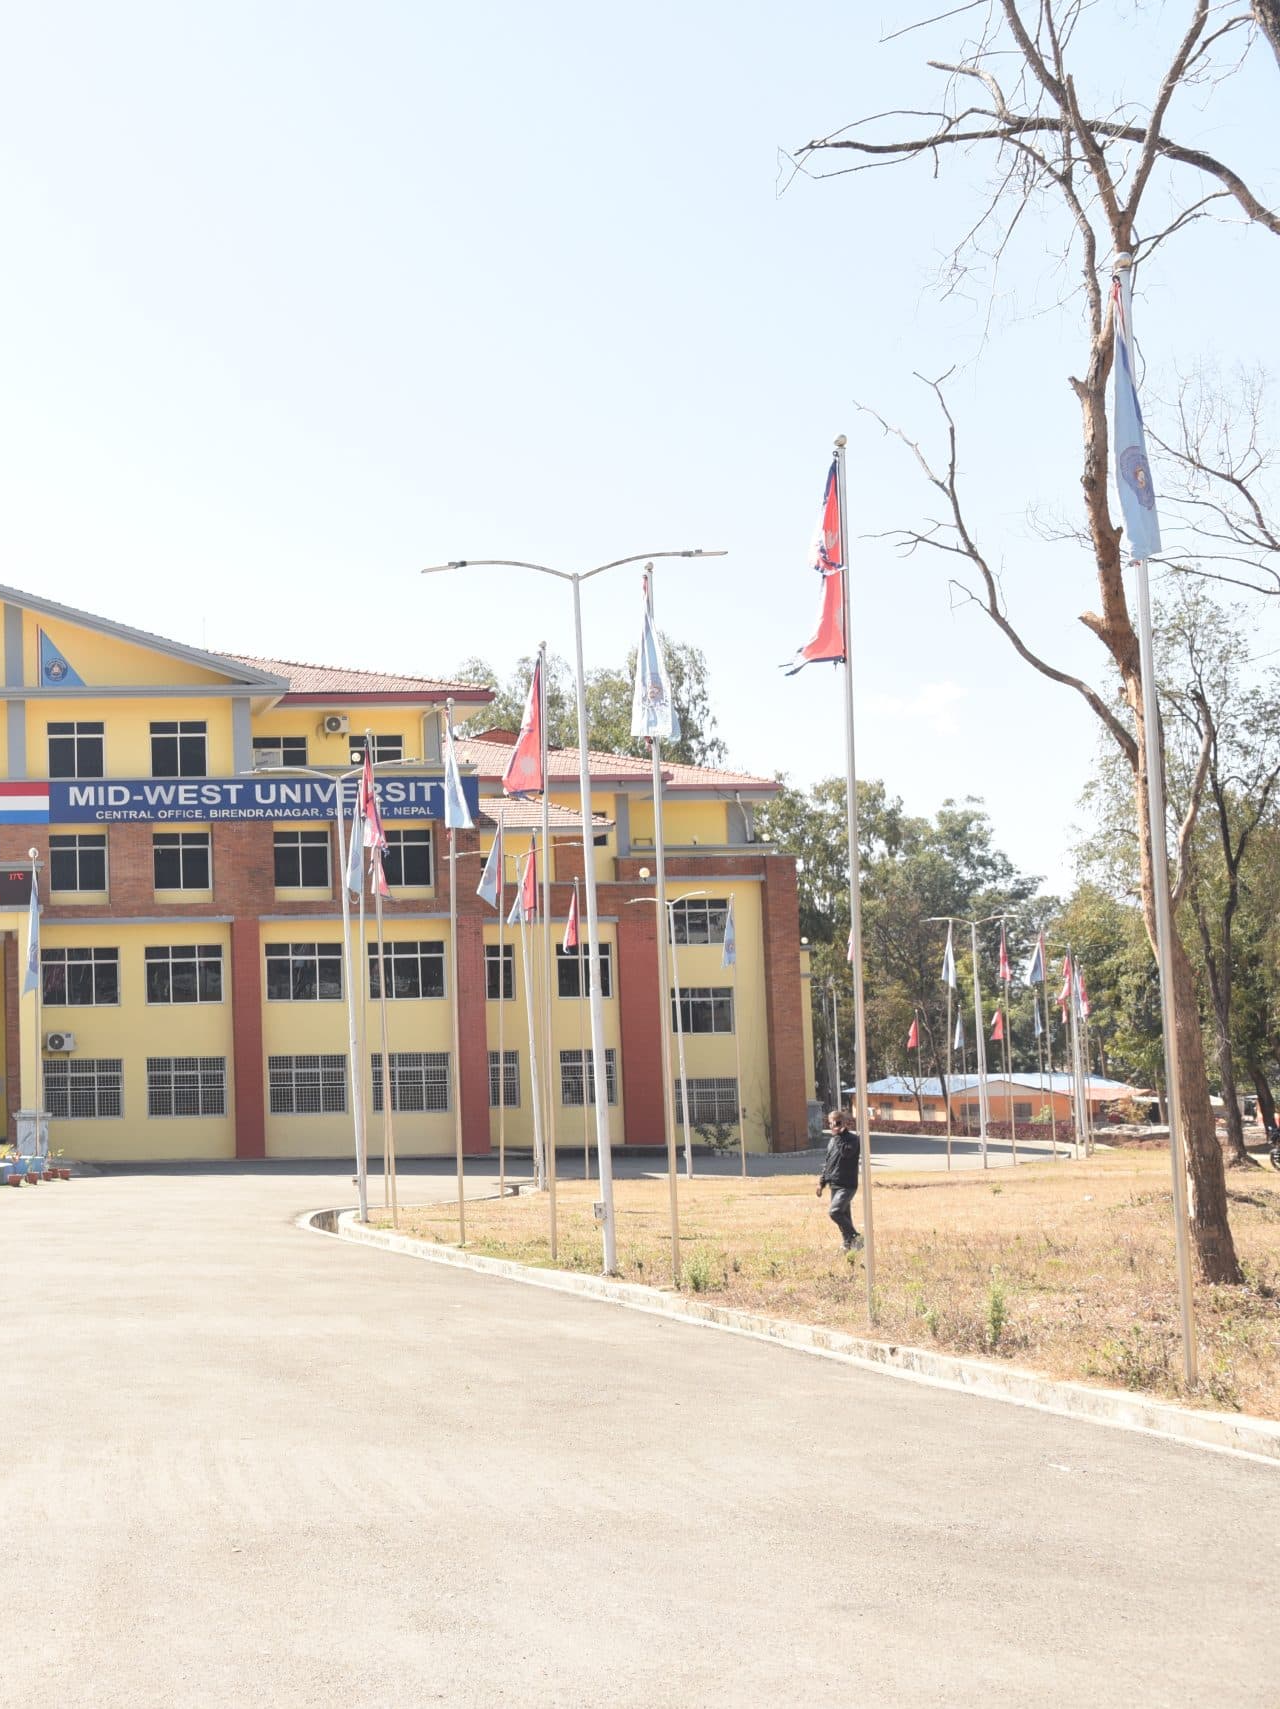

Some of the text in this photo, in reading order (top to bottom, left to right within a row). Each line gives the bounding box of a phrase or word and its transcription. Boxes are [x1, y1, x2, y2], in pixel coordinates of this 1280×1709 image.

[69, 784, 243, 806] MID-WEST
[96, 809, 154, 820] CENTRAL
[157, 808, 206, 819] OFFICE,
[209, 807, 322, 819] BIRENDRANAGAR,
[393, 806, 434, 816] NEPAL
